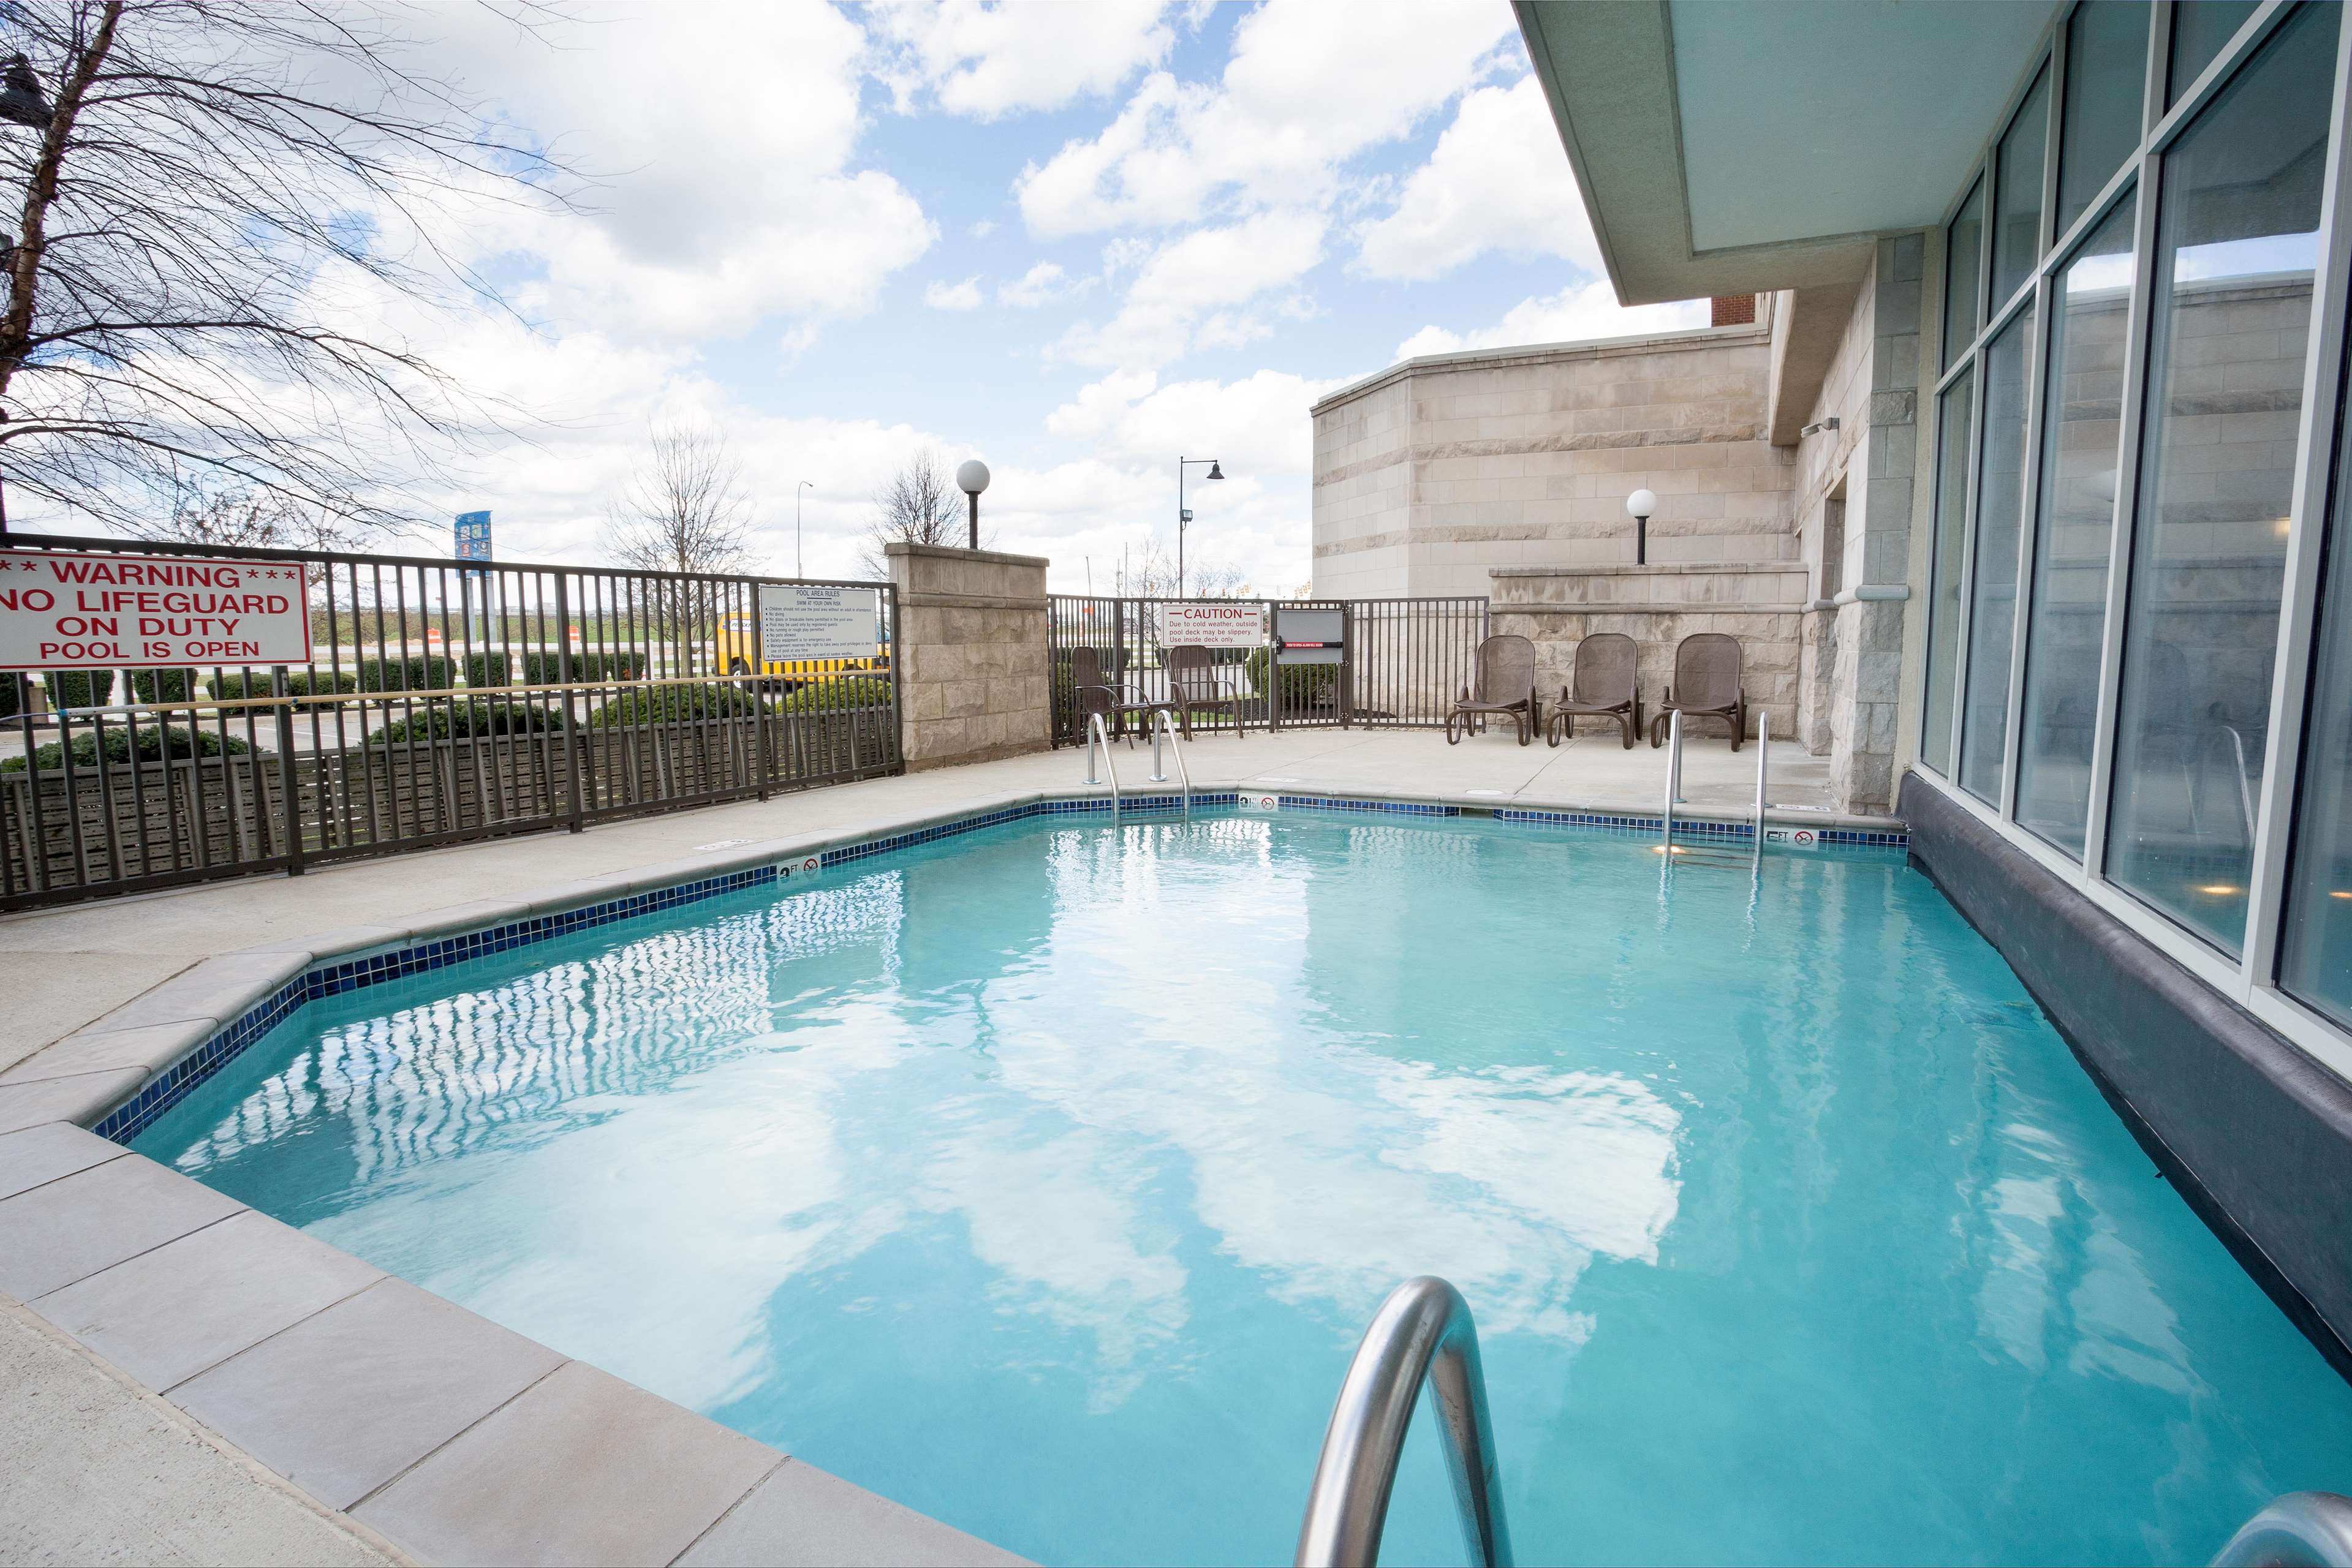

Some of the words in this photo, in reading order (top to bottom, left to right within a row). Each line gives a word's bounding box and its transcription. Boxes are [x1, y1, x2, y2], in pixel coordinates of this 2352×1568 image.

[50, 560, 241, 589] WARNING
[0, 589, 55, 612] NO
[76, 590, 289, 614] LIFEGUARD
[1184, 609, 1242, 619] CAUTION
[56, 616, 118, 636] ON
[138, 617, 240, 636] DUTY
[40, 642, 130, 660] POOL
[143, 641, 171, 658] IS
[185, 641, 260, 657] OPEN
